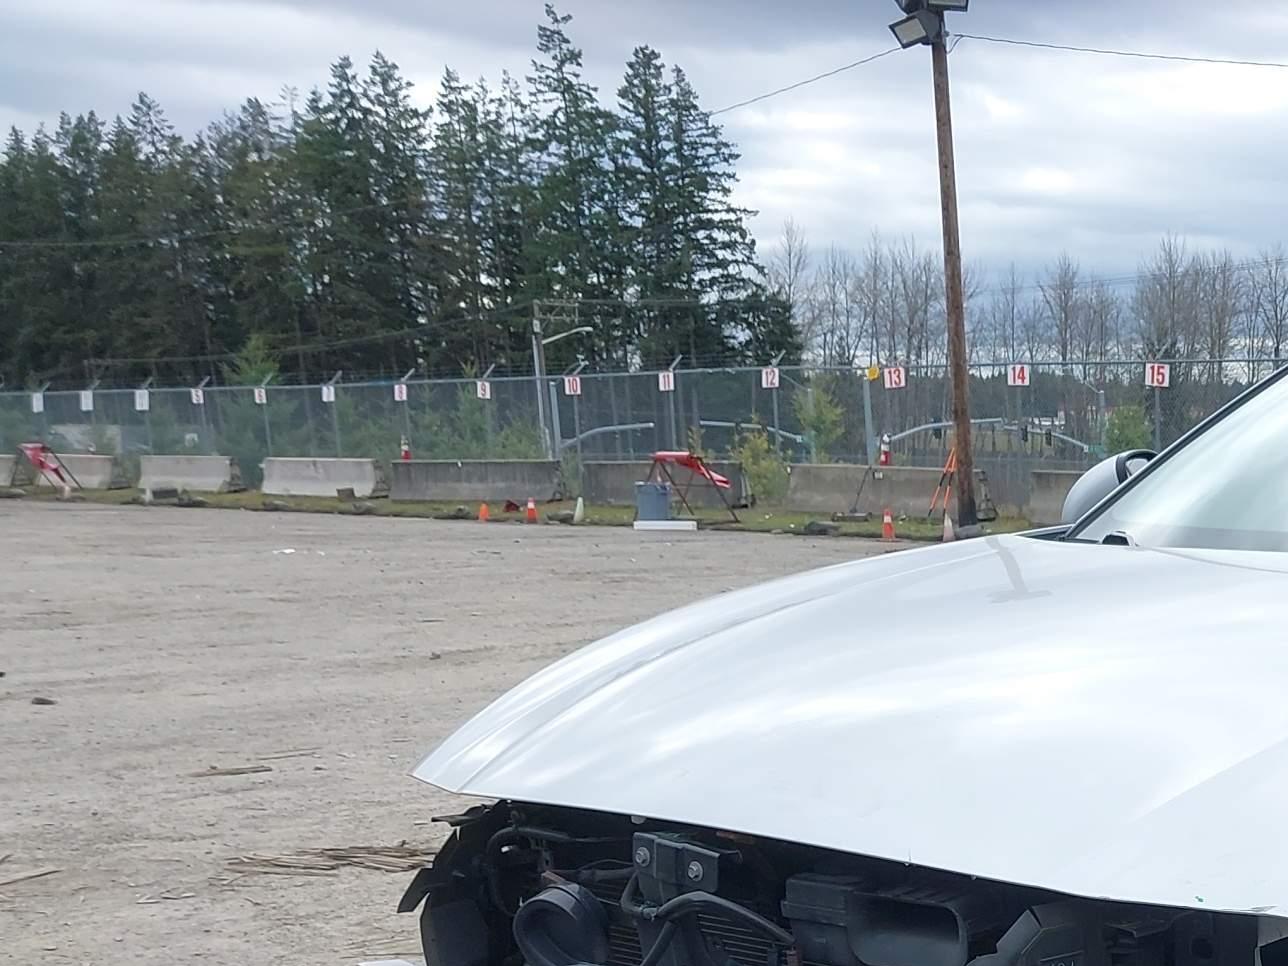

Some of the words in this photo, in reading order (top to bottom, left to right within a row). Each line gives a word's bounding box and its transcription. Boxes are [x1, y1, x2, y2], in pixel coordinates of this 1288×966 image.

[662, 374, 671, 389] 11
[764, 369, 776, 386] 12
[887, 368, 901, 386] 13
[1012, 366, 1026, 385] 14
[1150, 365, 1165, 385] 15
[480, 384, 487, 397] 9
[567, 378, 578, 393] 10
